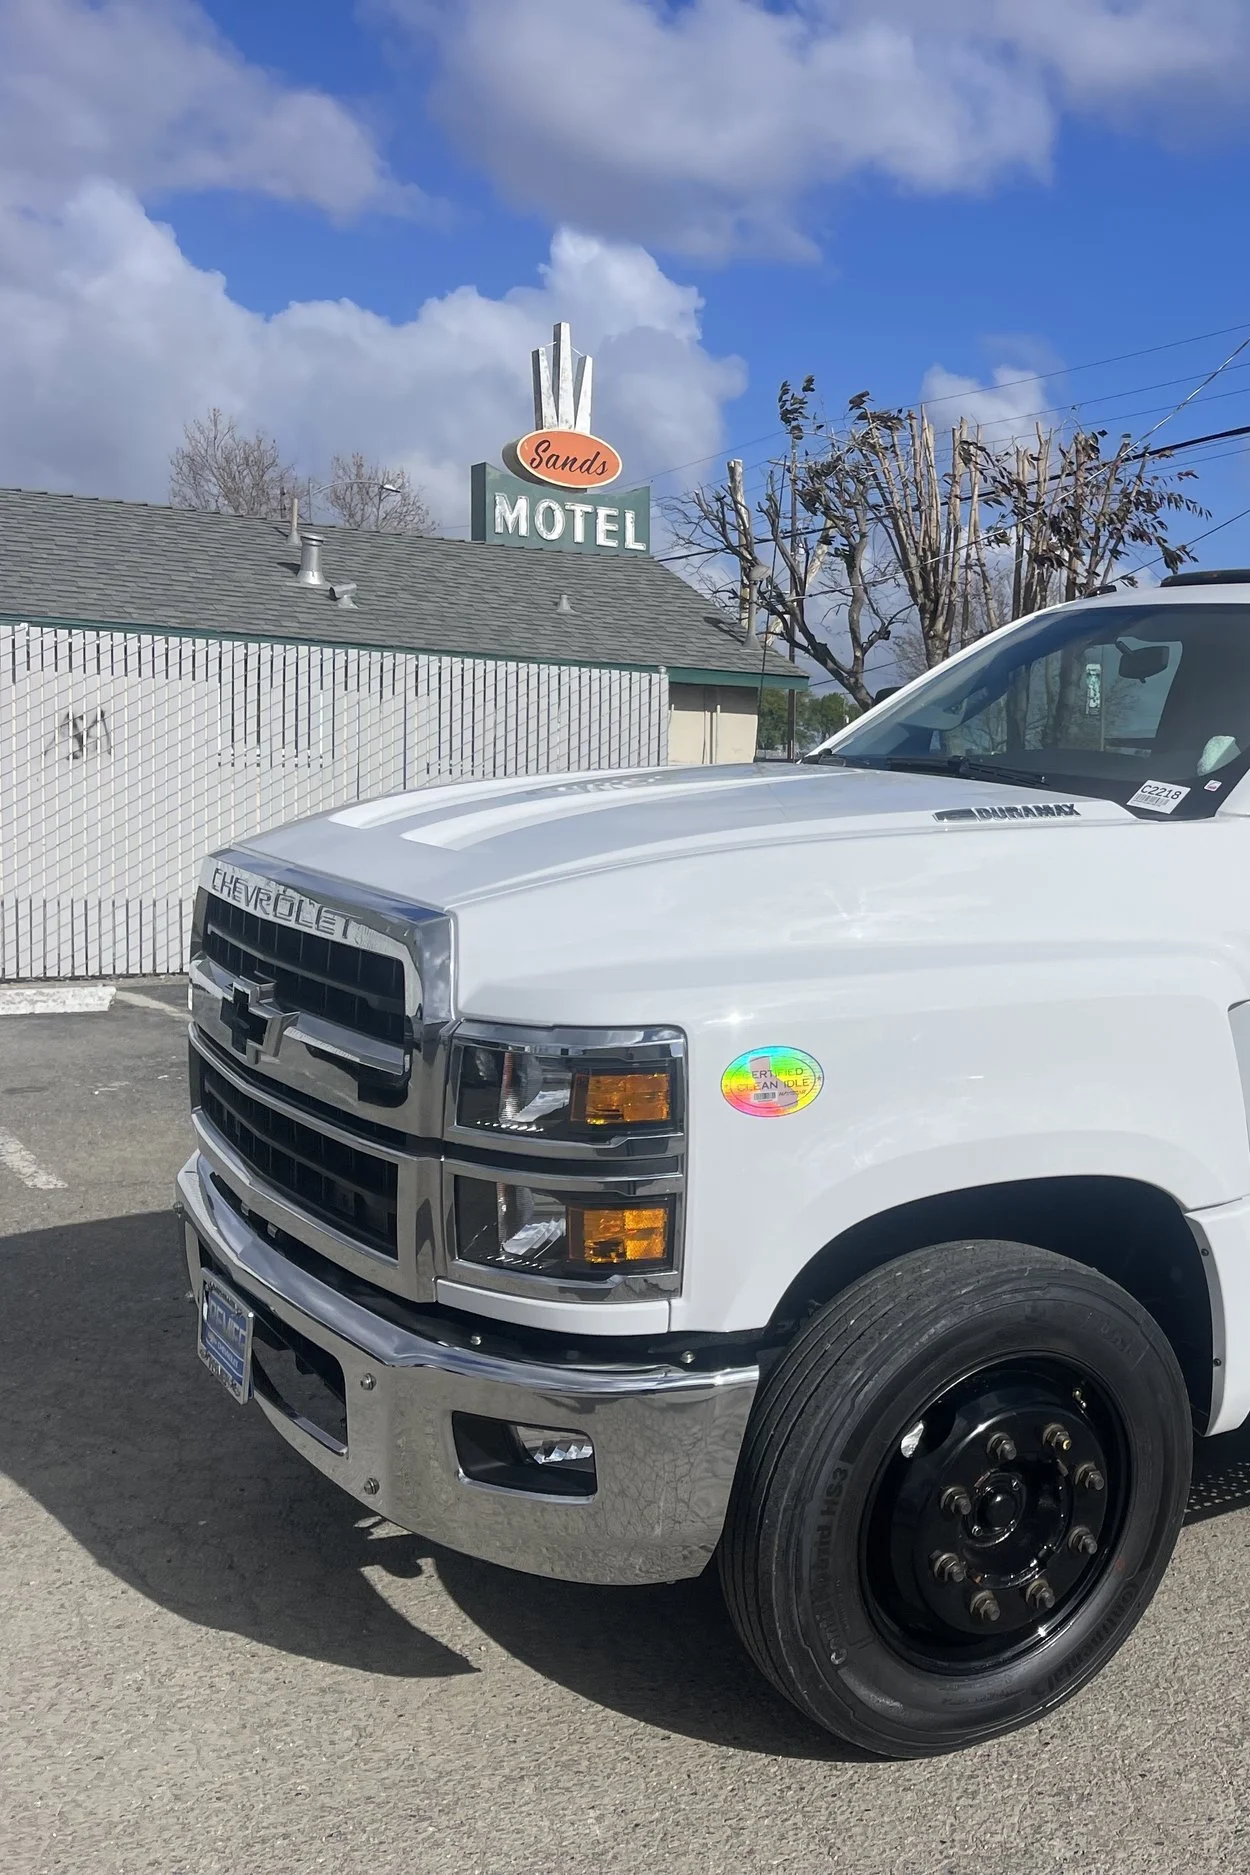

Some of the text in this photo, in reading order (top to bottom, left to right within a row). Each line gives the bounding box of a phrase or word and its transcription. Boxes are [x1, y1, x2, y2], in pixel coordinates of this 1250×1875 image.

[530, 439, 608, 476] Sands
[494, 492, 646, 550] MOTEL
[1140, 784, 1182, 800] C2218
[974, 803, 1081, 820] DURAMAX
[211, 867, 362, 940] CHEVROLET
[742, 1067, 804, 1080] ERTIFIED
[783, 1078, 810, 1088] IDLE
